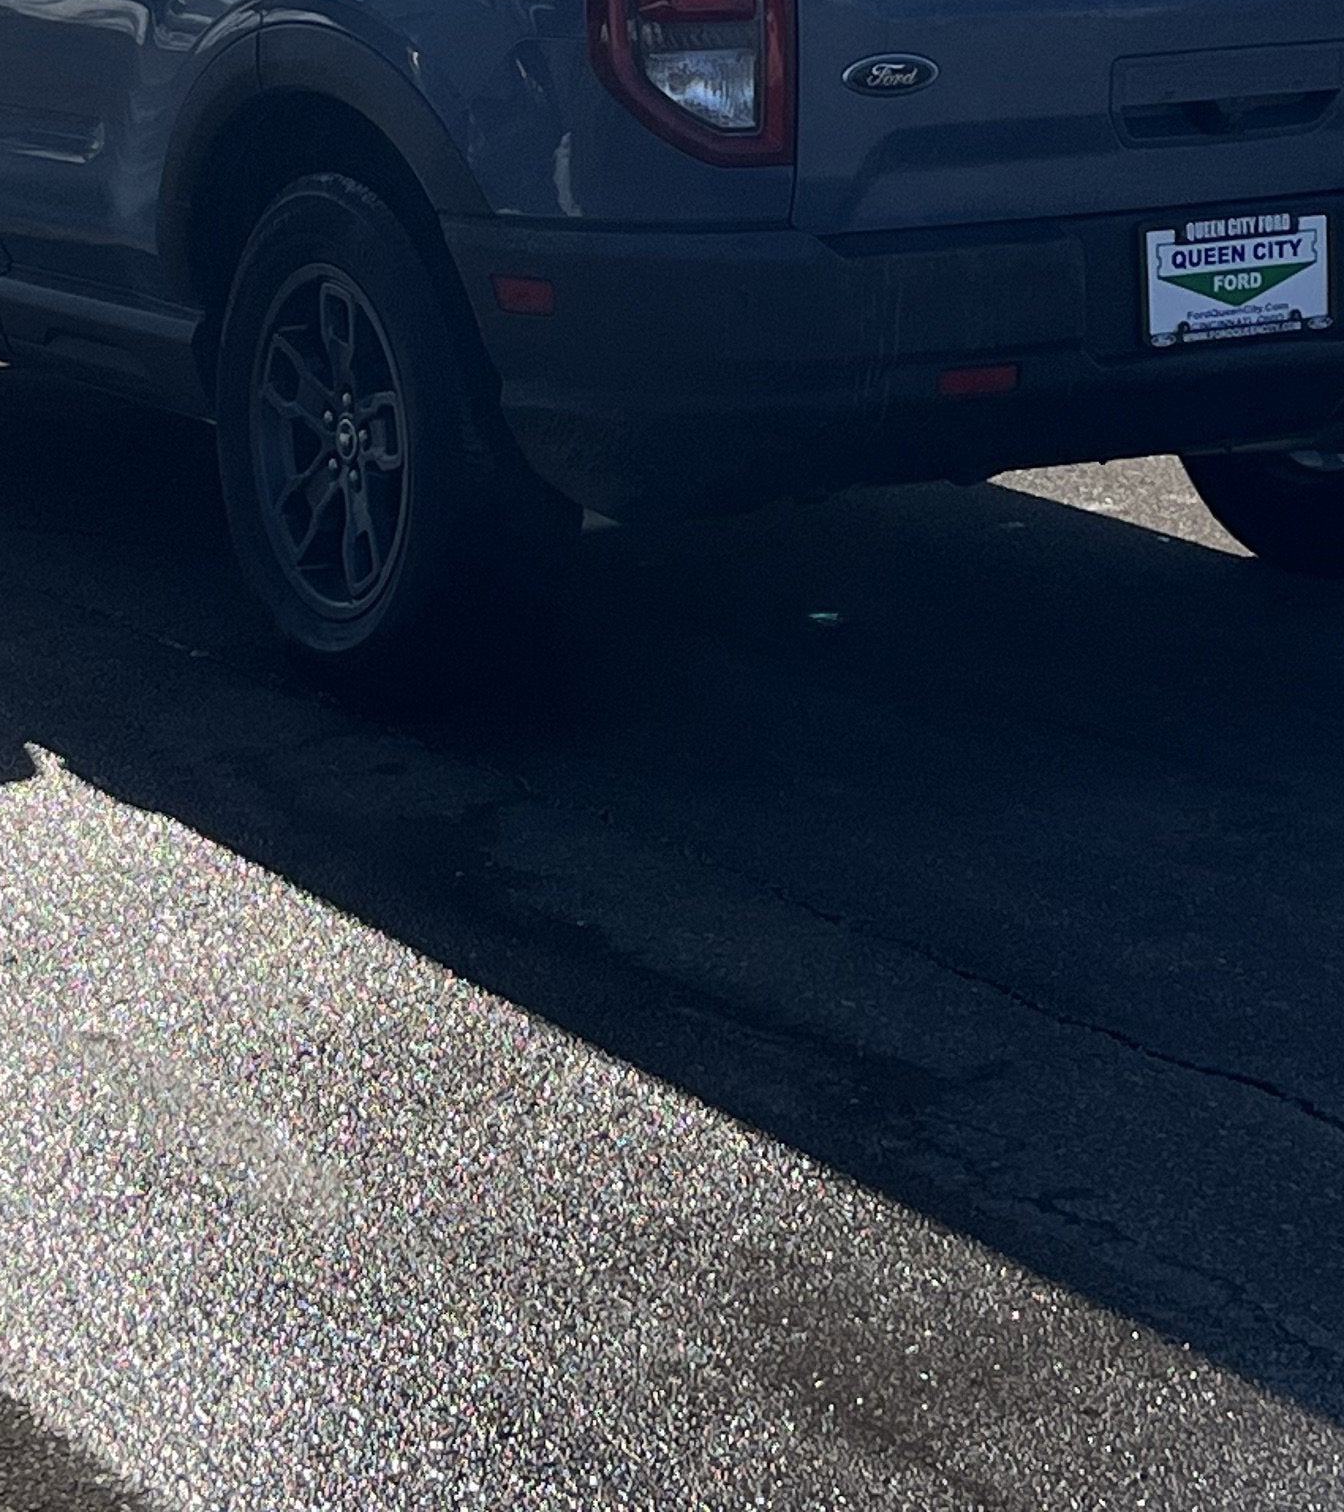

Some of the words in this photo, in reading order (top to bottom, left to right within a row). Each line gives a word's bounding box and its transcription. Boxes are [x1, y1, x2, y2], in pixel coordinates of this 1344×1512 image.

[1185, 219, 1226, 242] QUEEN
[1227, 216, 1257, 237] CITY
[1258, 213, 1291, 234] FORD
[1171, 244, 1246, 270] QUEEN
[1253, 238, 1303, 260] CITY
[1213, 271, 1263, 293] FORD
